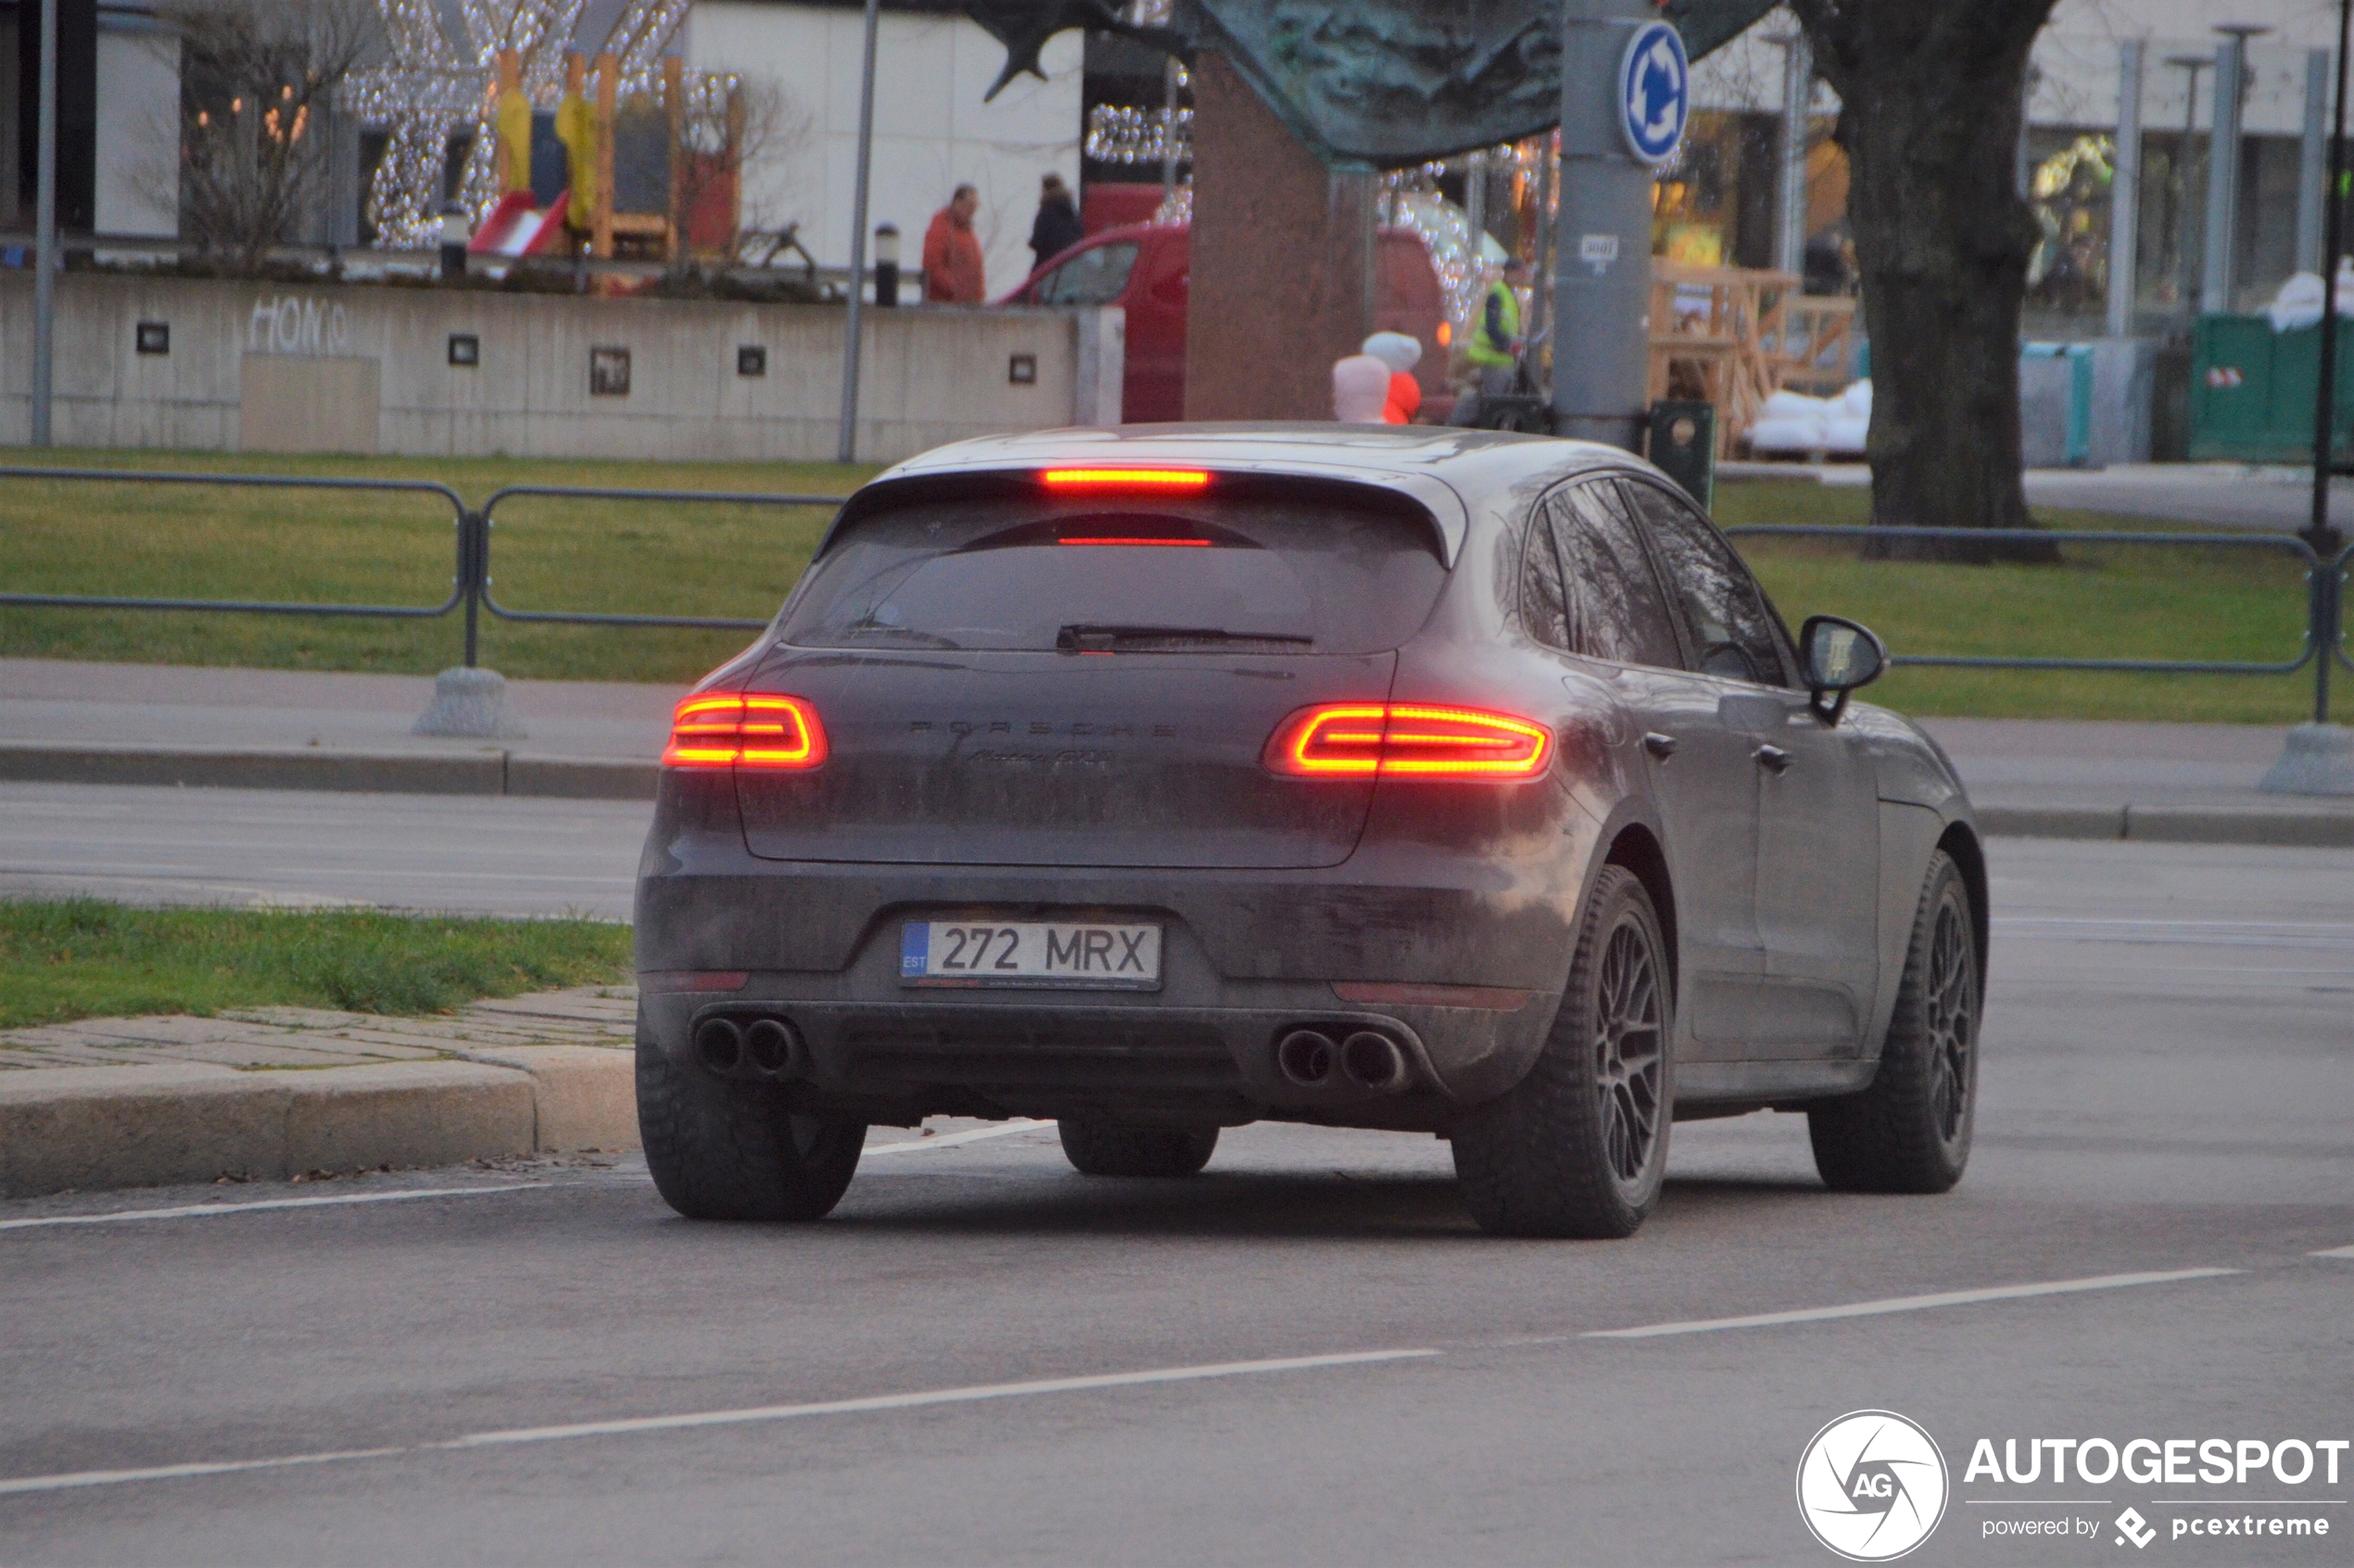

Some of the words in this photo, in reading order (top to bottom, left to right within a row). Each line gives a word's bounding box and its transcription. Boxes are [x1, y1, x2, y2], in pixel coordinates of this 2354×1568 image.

[909, 721, 1177, 738] PORSCHE
[942, 928, 1019, 969] 272
[1045, 929, 1146, 971] MRX
[903, 955, 927, 968] EST
